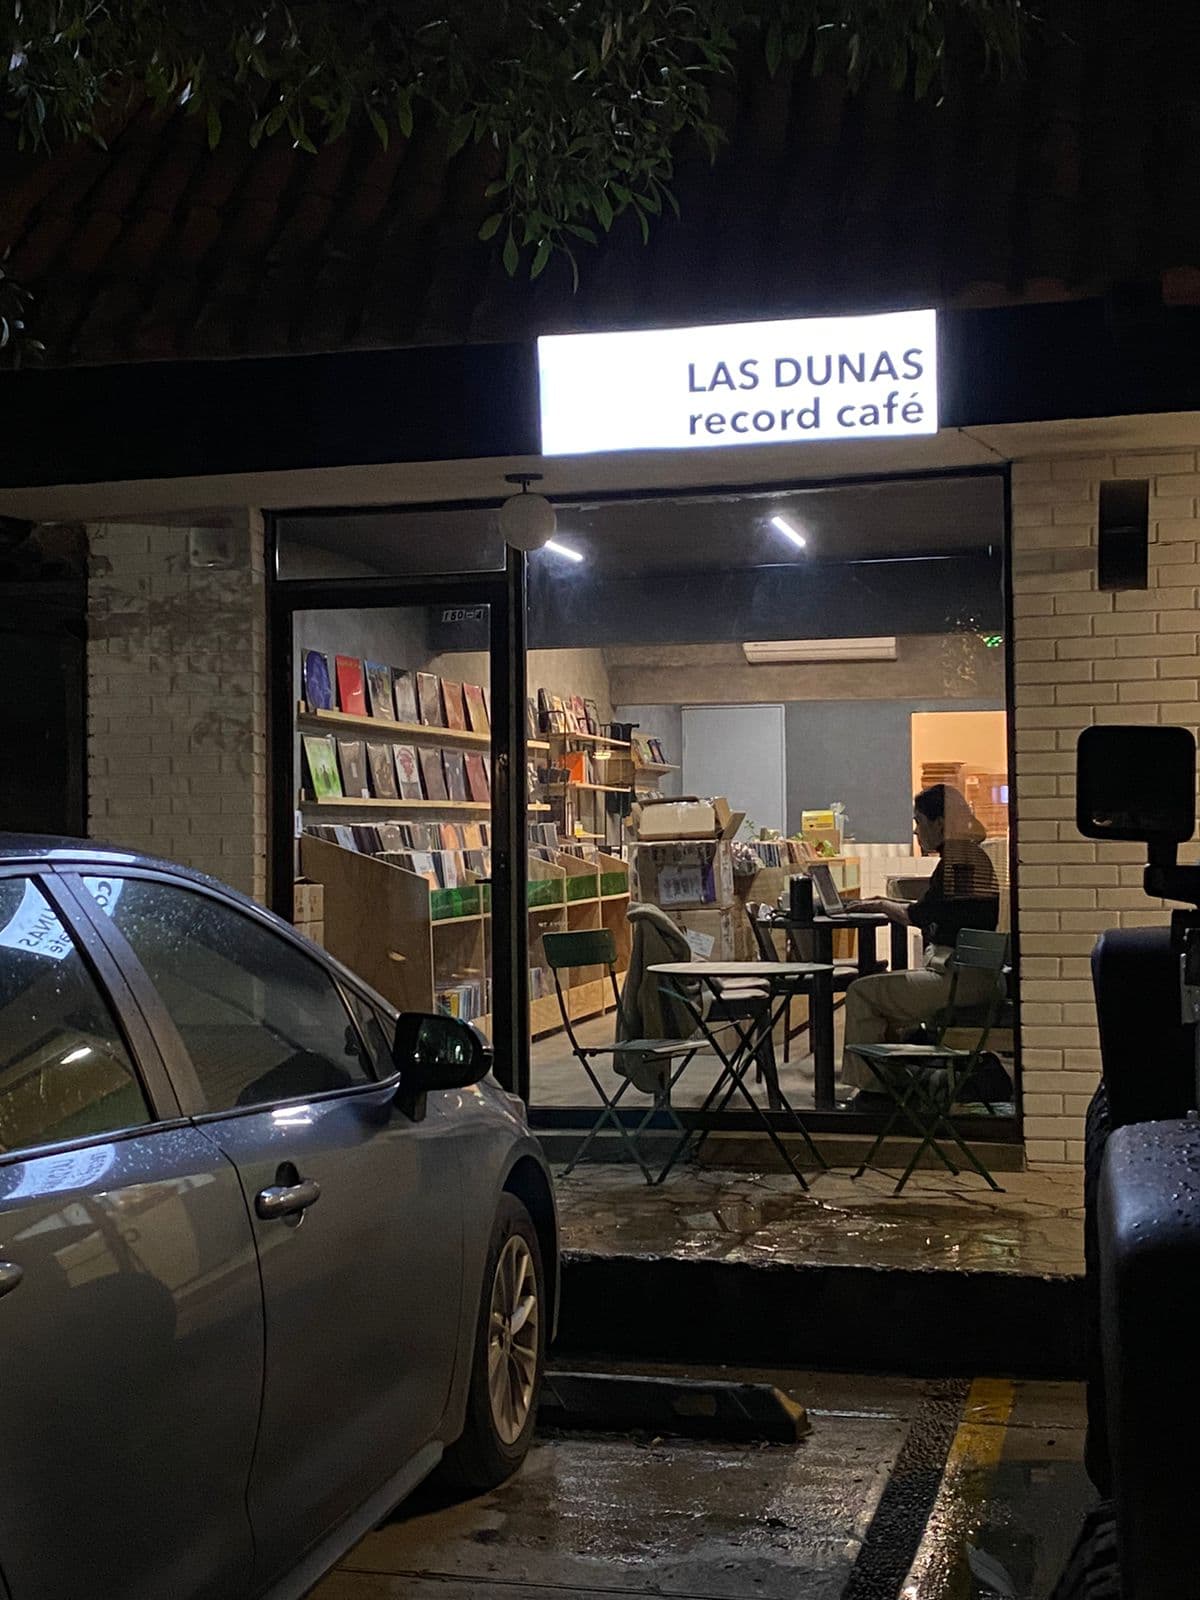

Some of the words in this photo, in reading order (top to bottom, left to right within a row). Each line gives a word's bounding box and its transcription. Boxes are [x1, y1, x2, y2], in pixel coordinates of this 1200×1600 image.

[688, 360, 759, 392] LAS
[774, 349, 923, 388] DUNAS
[689, 397, 820, 435] record
[836, 391, 924, 427] café
